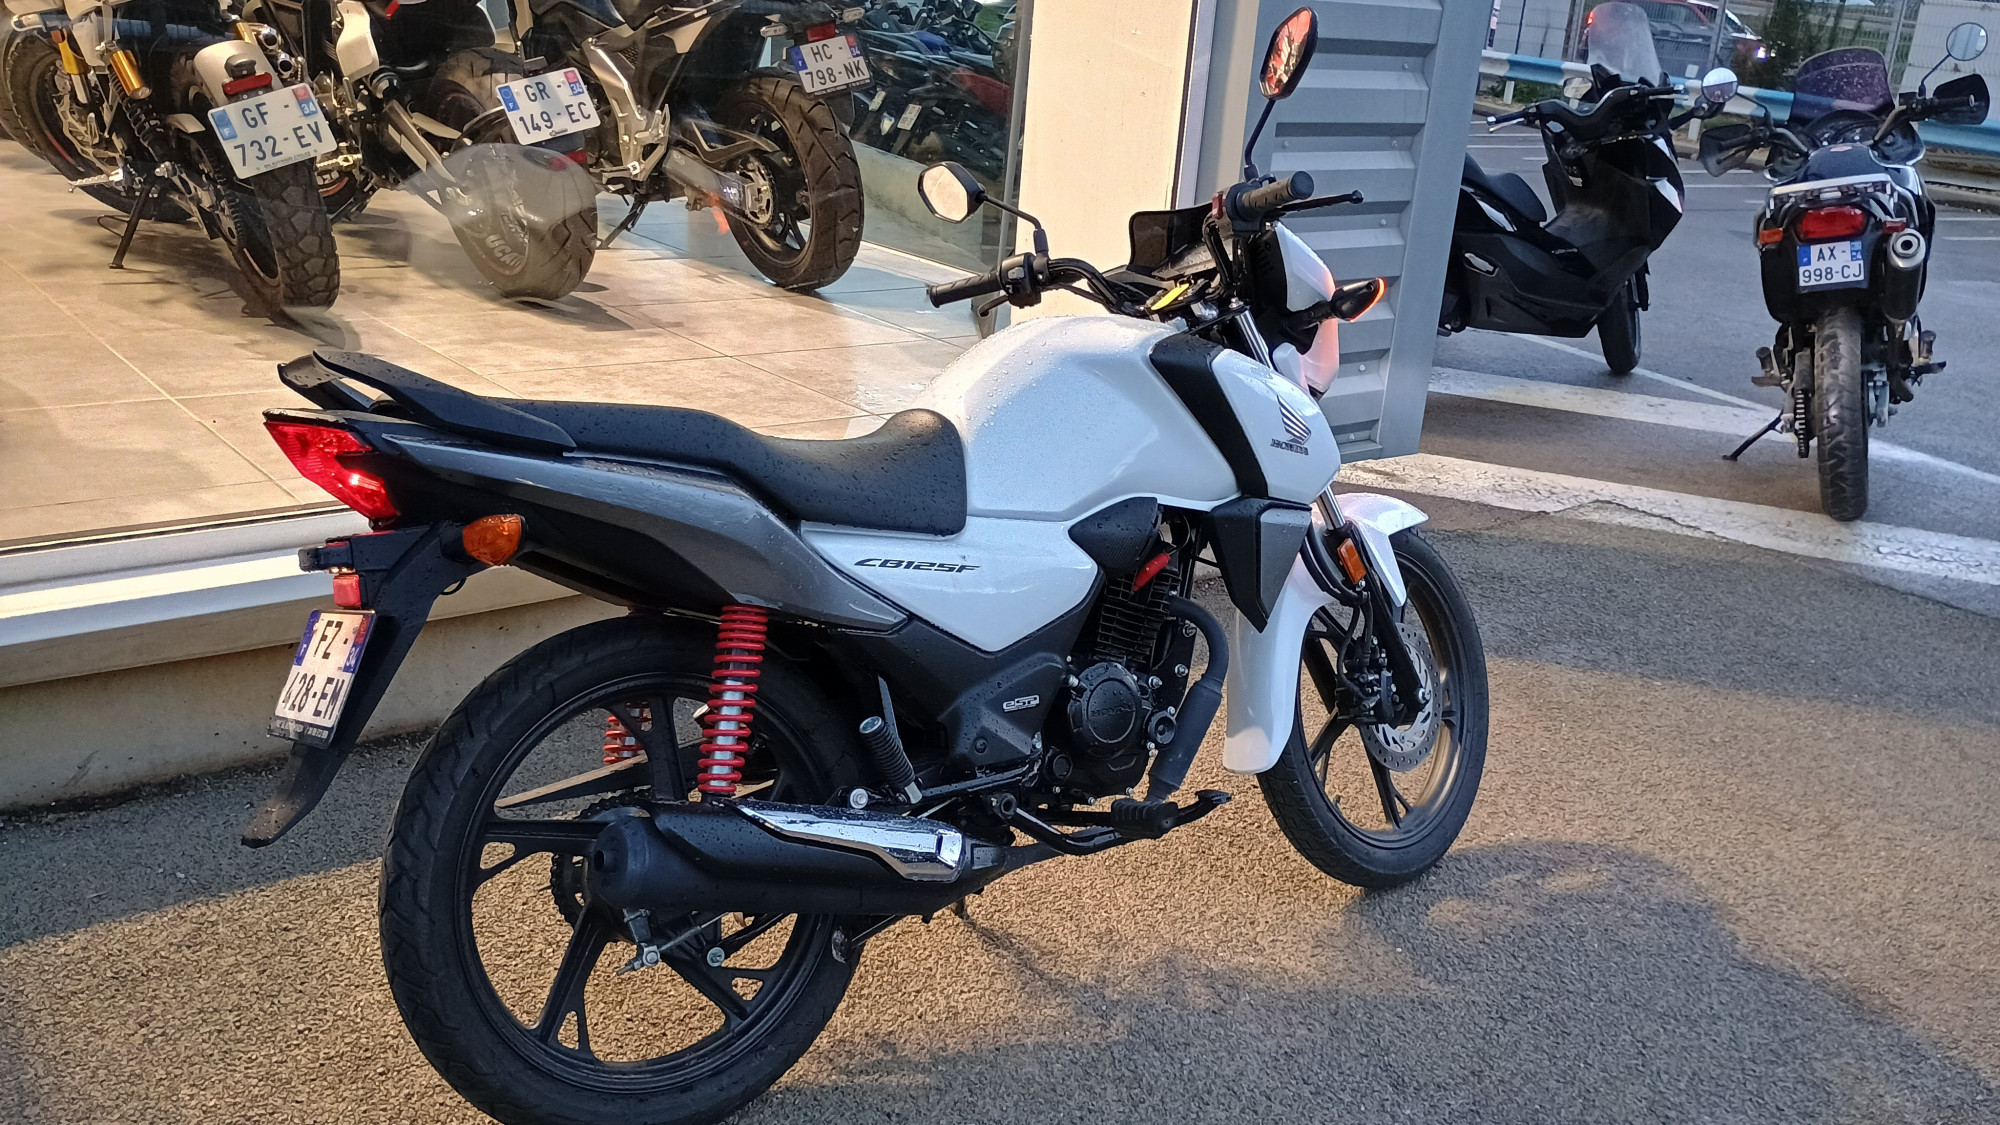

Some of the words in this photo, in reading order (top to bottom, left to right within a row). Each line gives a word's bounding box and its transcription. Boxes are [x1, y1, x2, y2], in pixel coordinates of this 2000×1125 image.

[810, 43, 833, 63] HC
[850, 47, 861, 56] 34
[805, 60, 865, 88] 798-NK
[524, 82, 551, 103] GR
[570, 82, 583, 94] 34
[241, 102, 269, 129] GF
[300, 101, 317, 115] 34
[519, 102, 591, 134] 149-EC
[233, 121, 323, 167] 732-EV
[1817, 245, 1837, 262] AX
[1802, 263, 1862, 283] 998-CJ
[1270, 438, 1309, 456] HONDA
[854, 558, 981, 573] CB125F
[314, 620, 344, 660] FZ
[282, 671, 345, 720] 428-EM
